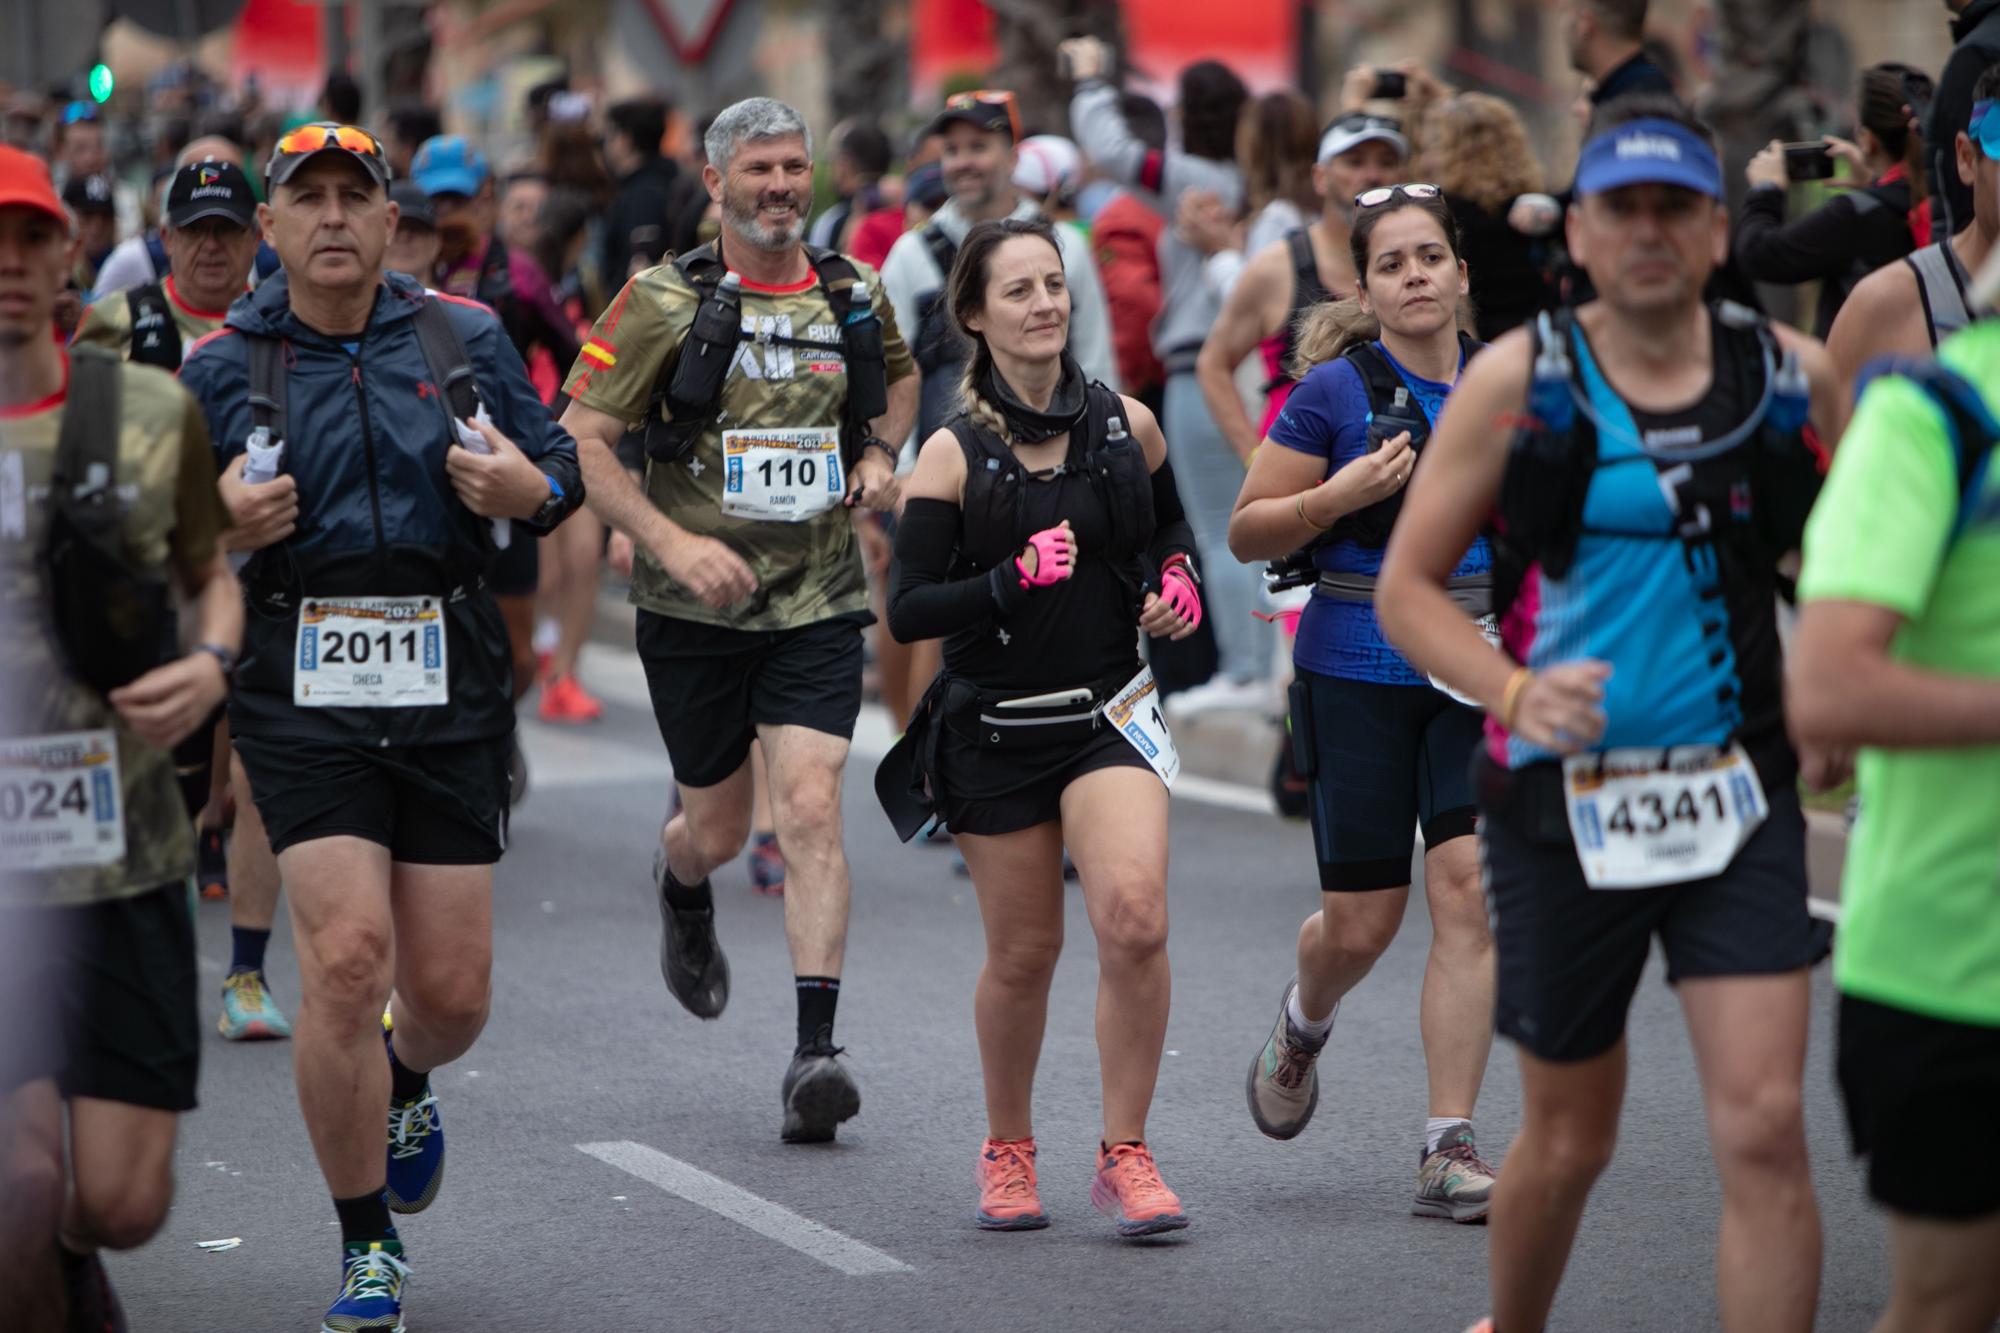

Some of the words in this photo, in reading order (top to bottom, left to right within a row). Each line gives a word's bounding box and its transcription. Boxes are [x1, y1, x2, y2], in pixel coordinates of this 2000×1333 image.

[758, 458, 815, 486] 110
[321, 630, 416, 663] 2011
[352, 673, 382, 686] CHECA
[1608, 782, 1726, 838] 4341
